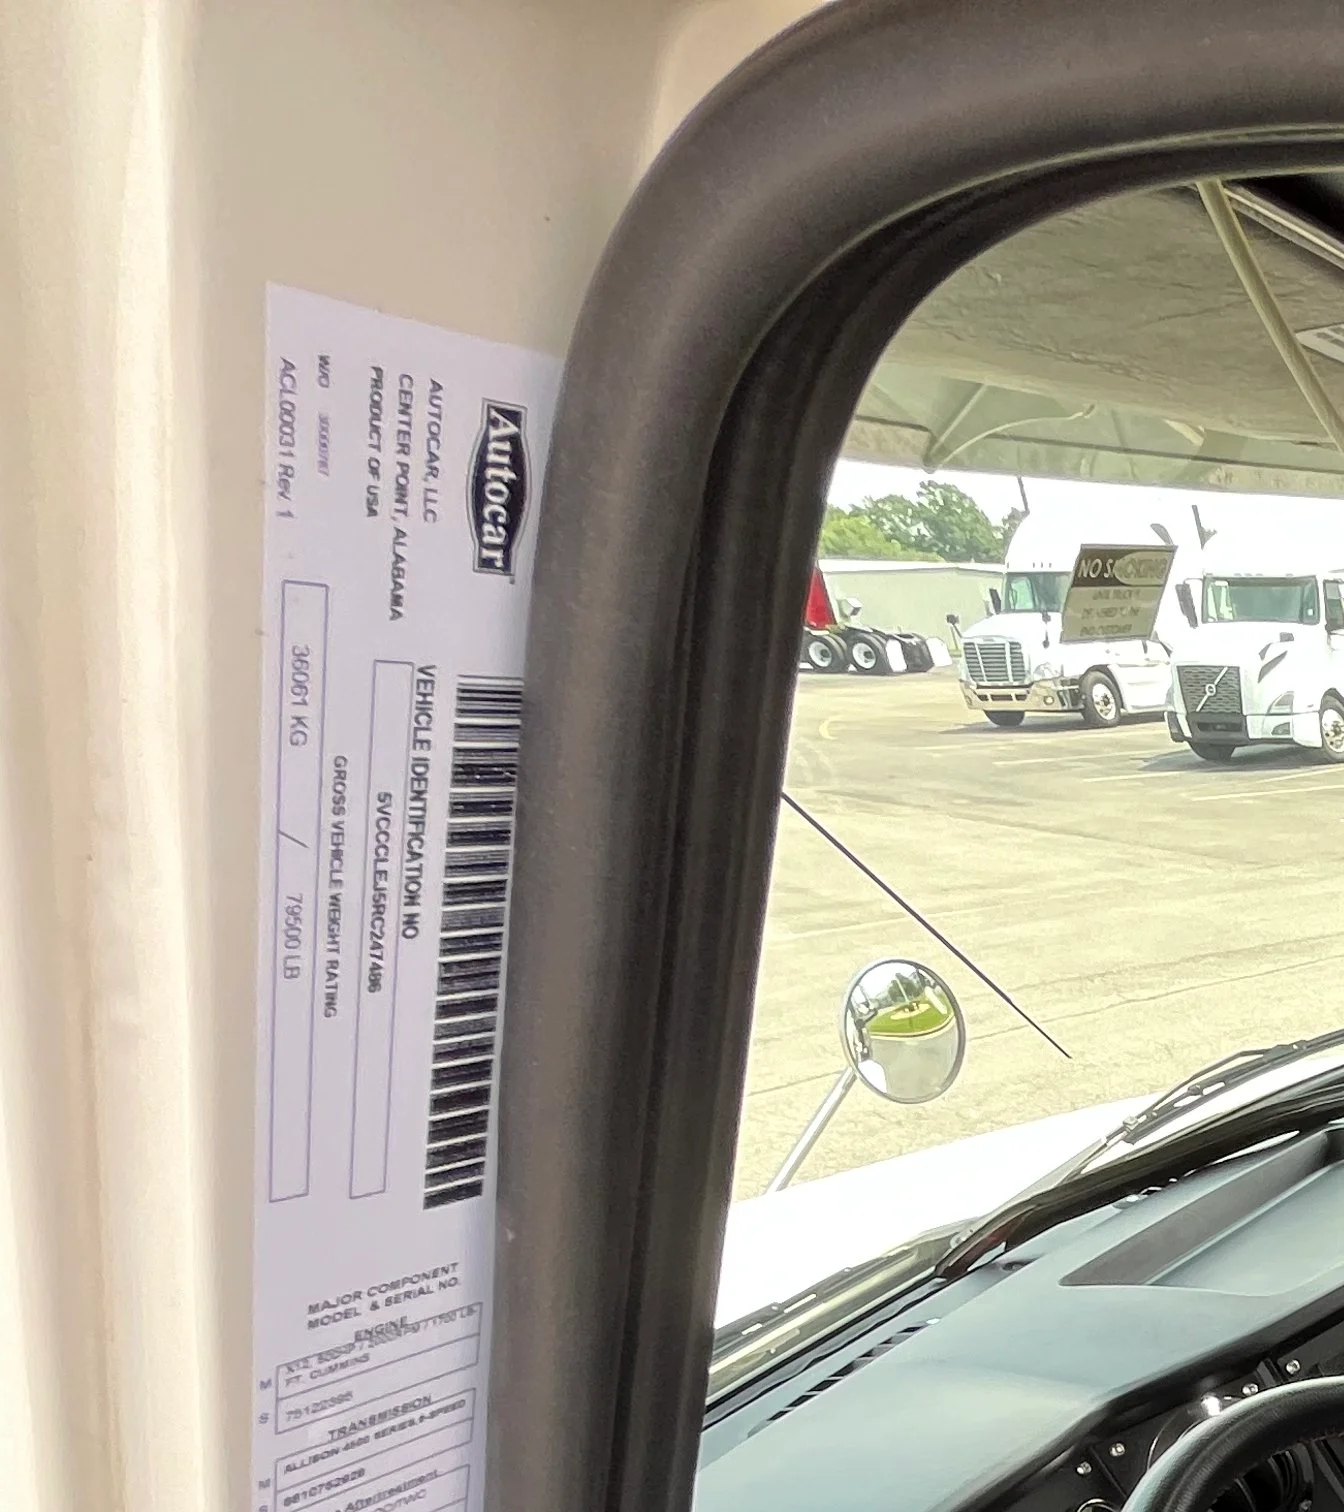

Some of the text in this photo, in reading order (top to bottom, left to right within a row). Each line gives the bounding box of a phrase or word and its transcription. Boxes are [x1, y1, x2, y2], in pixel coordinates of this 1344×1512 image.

[278, 355, 297, 456] ACL00031
[366, 364, 384, 518] PRODUCT OF USA
[422, 377, 444, 524] AUTOCAR, LLC
[389, 372, 414, 621] CENTER POINT, ALABAMA
[481, 406, 522, 568] Autocar
[1078, 558, 1103, 579] NO
[290, 644, 311, 708] 36061
[288, 714, 309, 748] KG
[400, 664, 438, 940] VEHICLE IDENTIFICATION NO
[323, 754, 348, 1019] GROSS VEHICLE WEIGHT RATING
[284, 892, 304, 951] 79500
[283, 954, 302, 981] LB
[307, 1262, 459, 1314] MAJOR COMPONENT
[307, 1284, 434, 1330] MODEL & SERIAL
[354, 1316, 408, 1342] ENGINE
[328, 1394, 432, 1442] TRANSMISSION
[284, 1447, 341, 1475] ALLISON
